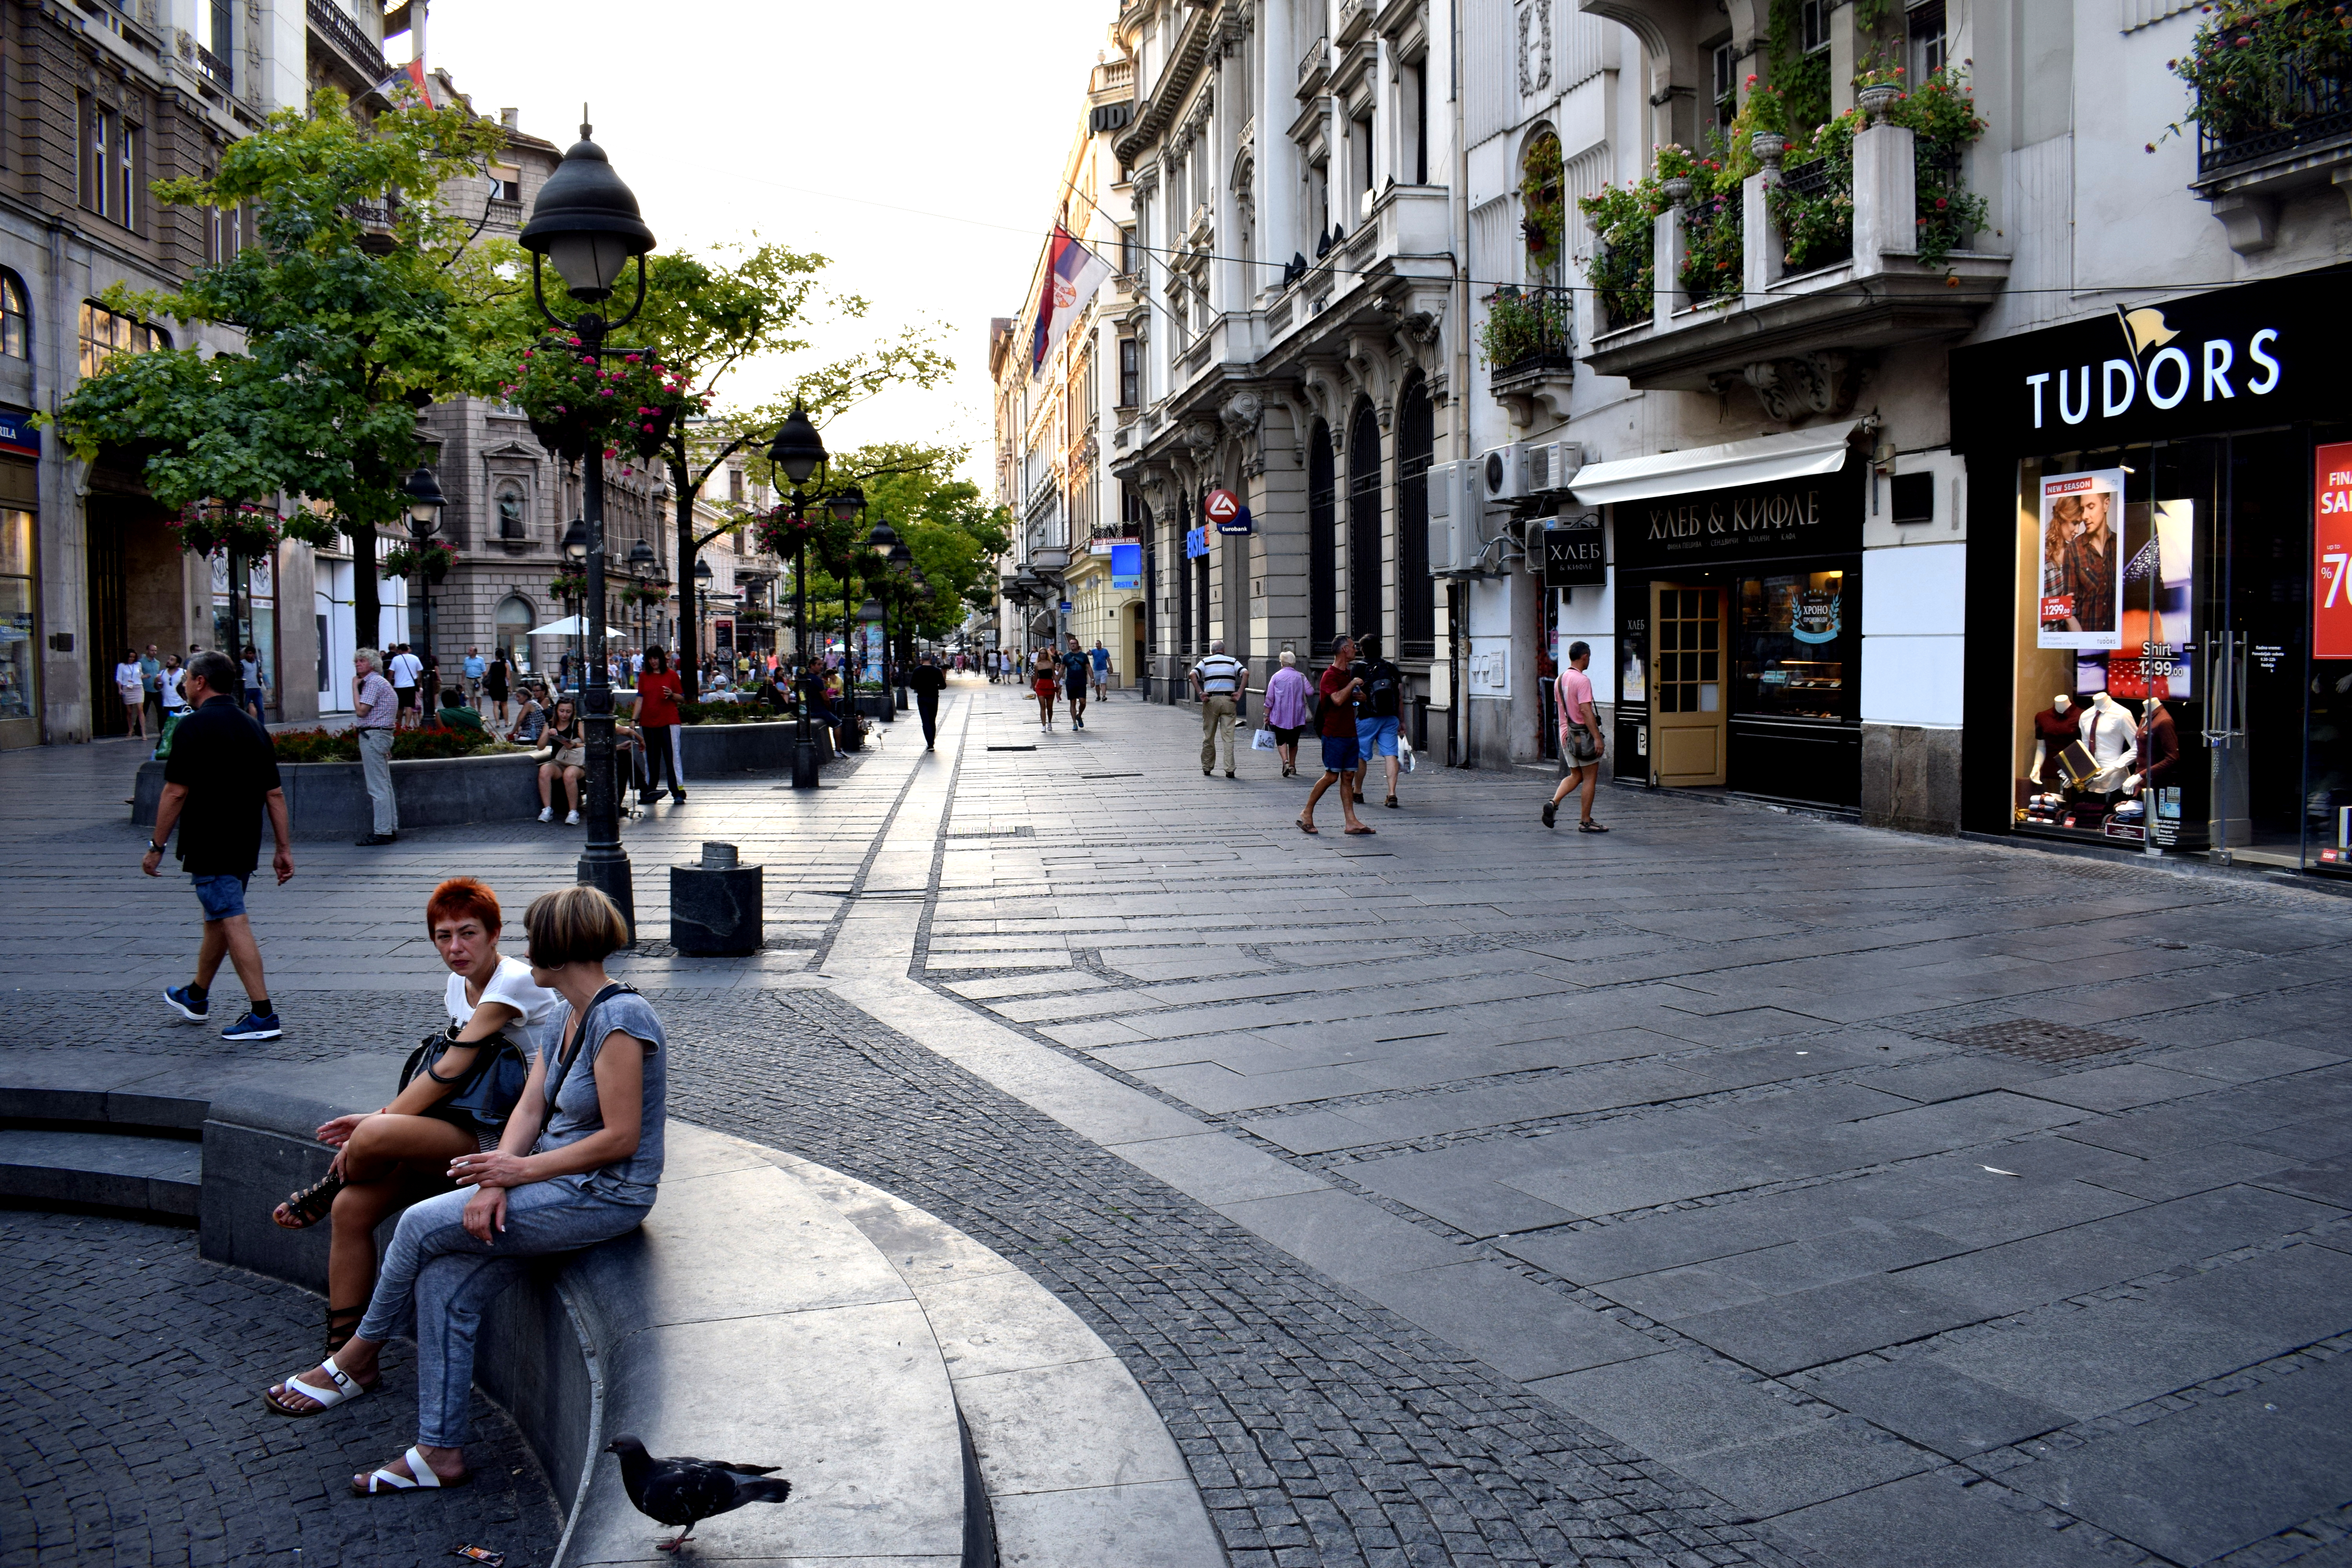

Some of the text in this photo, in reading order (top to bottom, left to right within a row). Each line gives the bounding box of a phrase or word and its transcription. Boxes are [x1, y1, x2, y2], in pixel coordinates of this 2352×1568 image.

[2026, 328, 2279, 428] TUDORS
[2047, 480, 2091, 494] NEW SEASON
[1647, 490, 1820, 540] ХЛЕБ & КИФЛЕ
[1187, 526, 1209, 559] ERSTE
[1711, 537, 1739, 546] СЕНДВИЧИ
[1550, 543, 1600, 560] ХЛЕБ
[1803, 606, 1828, 614] ХРОНО
[1628, 619, 1644, 630] ХЛЕБ
[2142, 642, 2171, 656] Shirt
[2139, 661, 2183, 676] 1299,00
[1640, 733, 1645, 748] P
